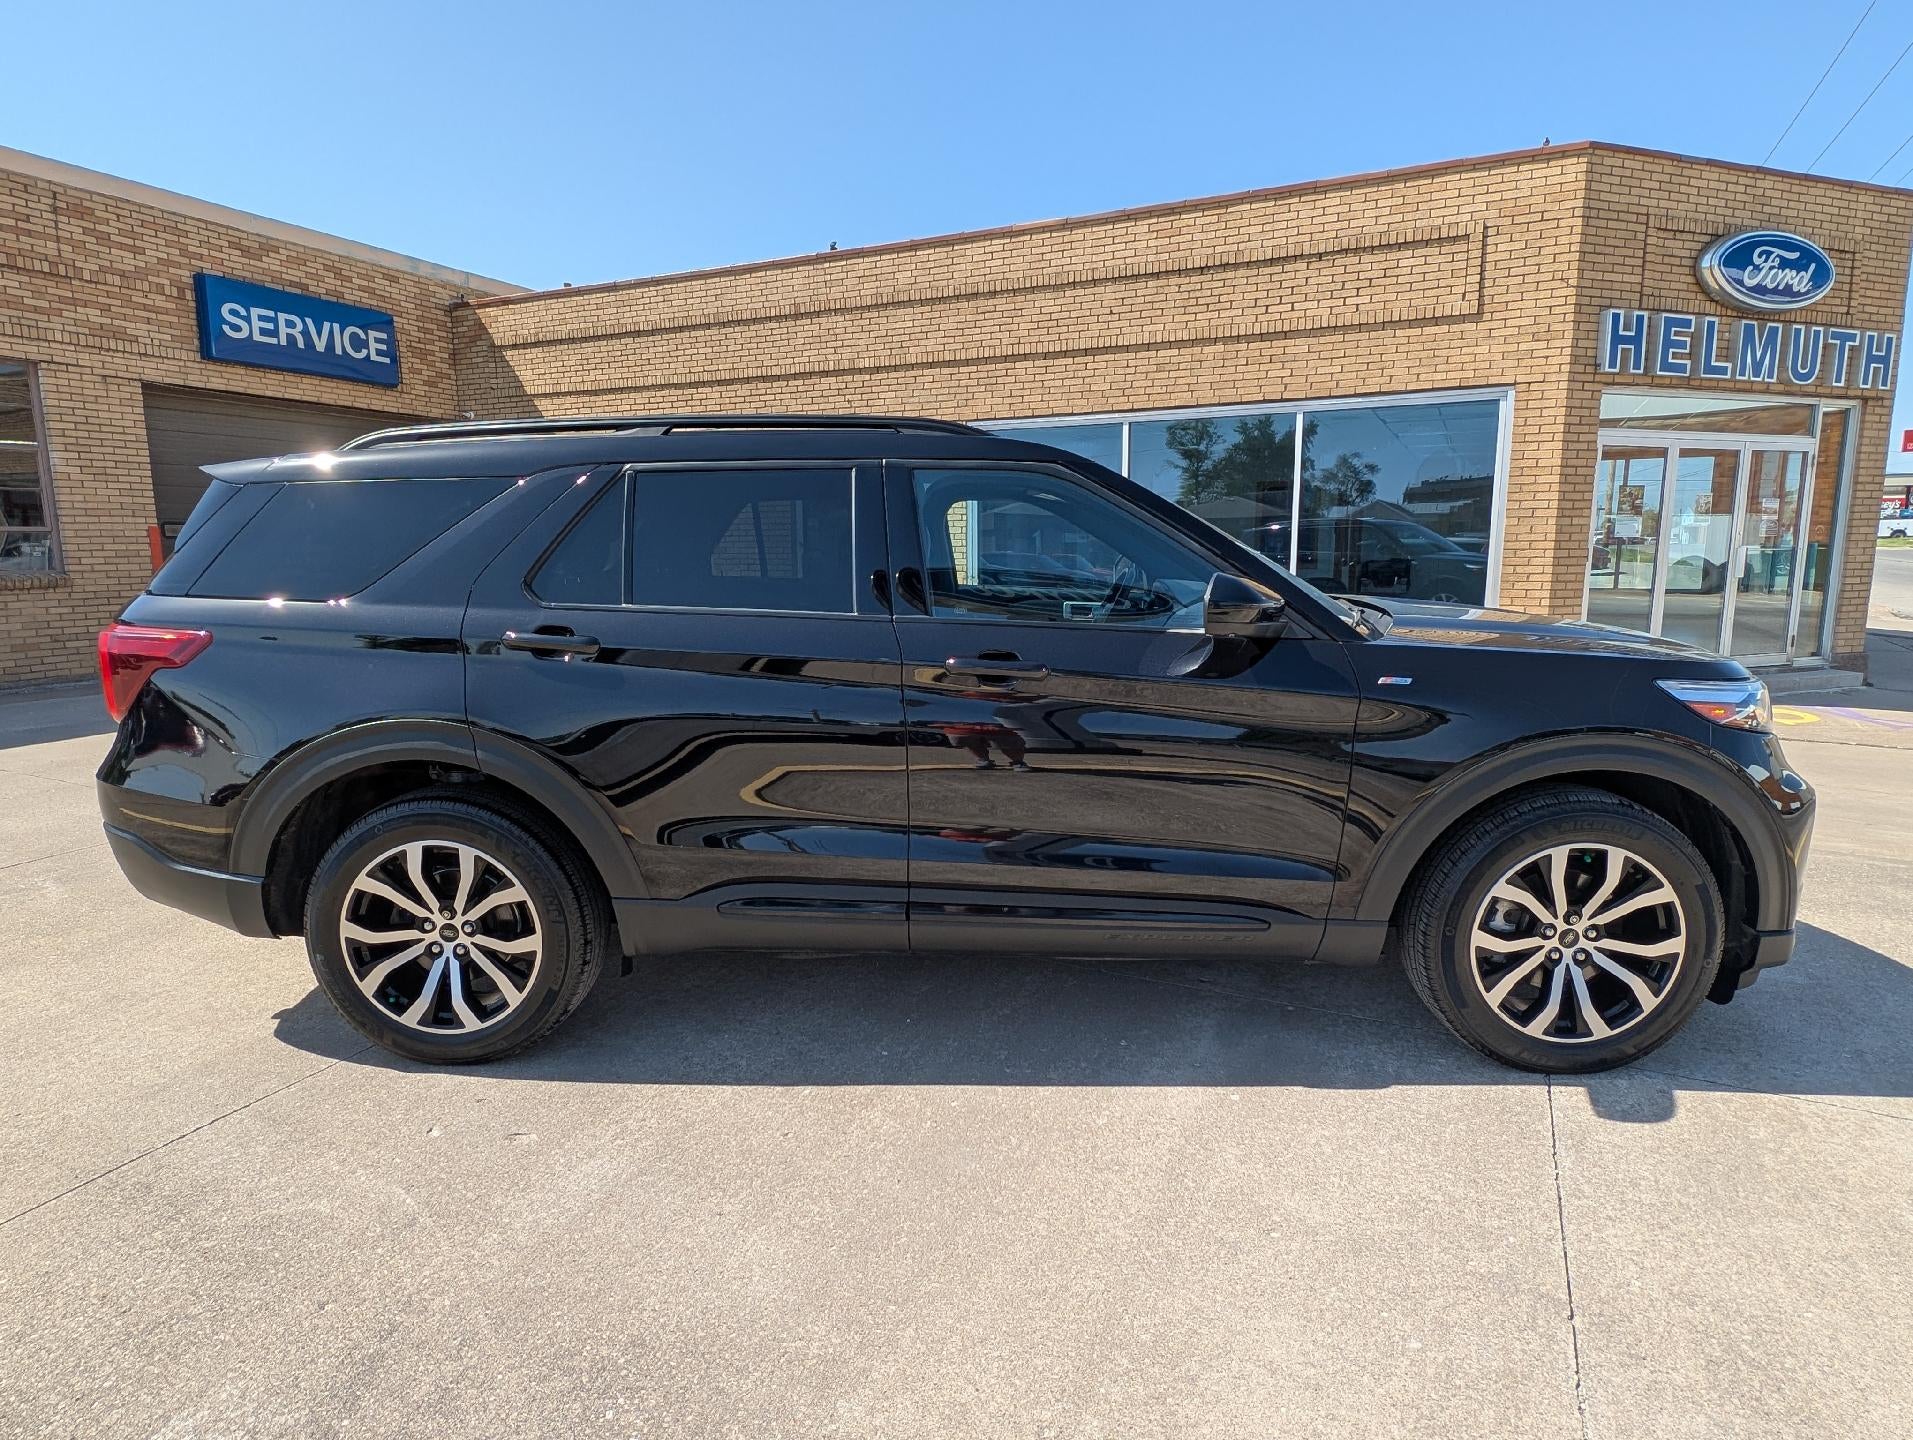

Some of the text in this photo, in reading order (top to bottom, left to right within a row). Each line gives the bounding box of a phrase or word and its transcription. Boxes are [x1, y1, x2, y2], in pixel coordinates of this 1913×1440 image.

[1743, 246, 1816, 293] Ford
[221, 302, 391, 364] SERVICE
[1603, 309, 1896, 390] HELMUTH
